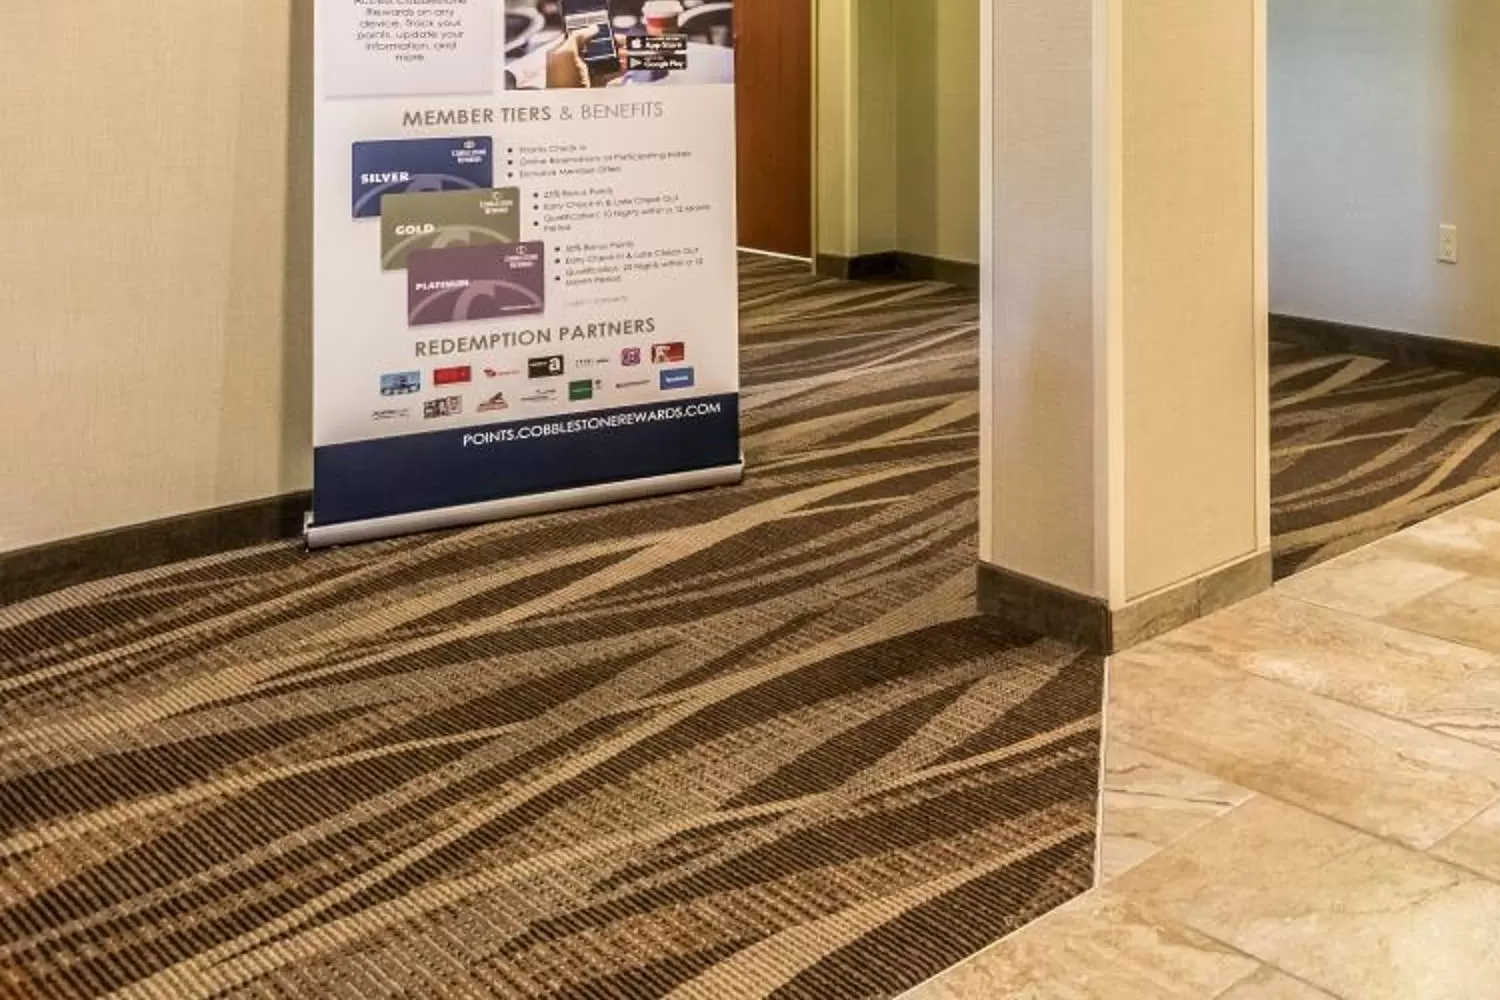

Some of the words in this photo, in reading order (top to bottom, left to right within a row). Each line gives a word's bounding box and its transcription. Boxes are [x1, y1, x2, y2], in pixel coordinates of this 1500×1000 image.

[402, 107, 494, 127] MEMBER
[499, 105, 552, 124] TIERS
[558, 105, 574, 121] &
[581, 101, 664, 120] BENEFITS
[361, 171, 409, 185] SILVER
[395, 223, 435, 236] GOLD
[415, 279, 470, 292] PLATINUM
[415, 327, 551, 357] REDEMPTION
[559, 317, 656, 342] PARTNERS
[463, 402, 722, 447] POINTS.COBBLESTONEREWARDS.COM
